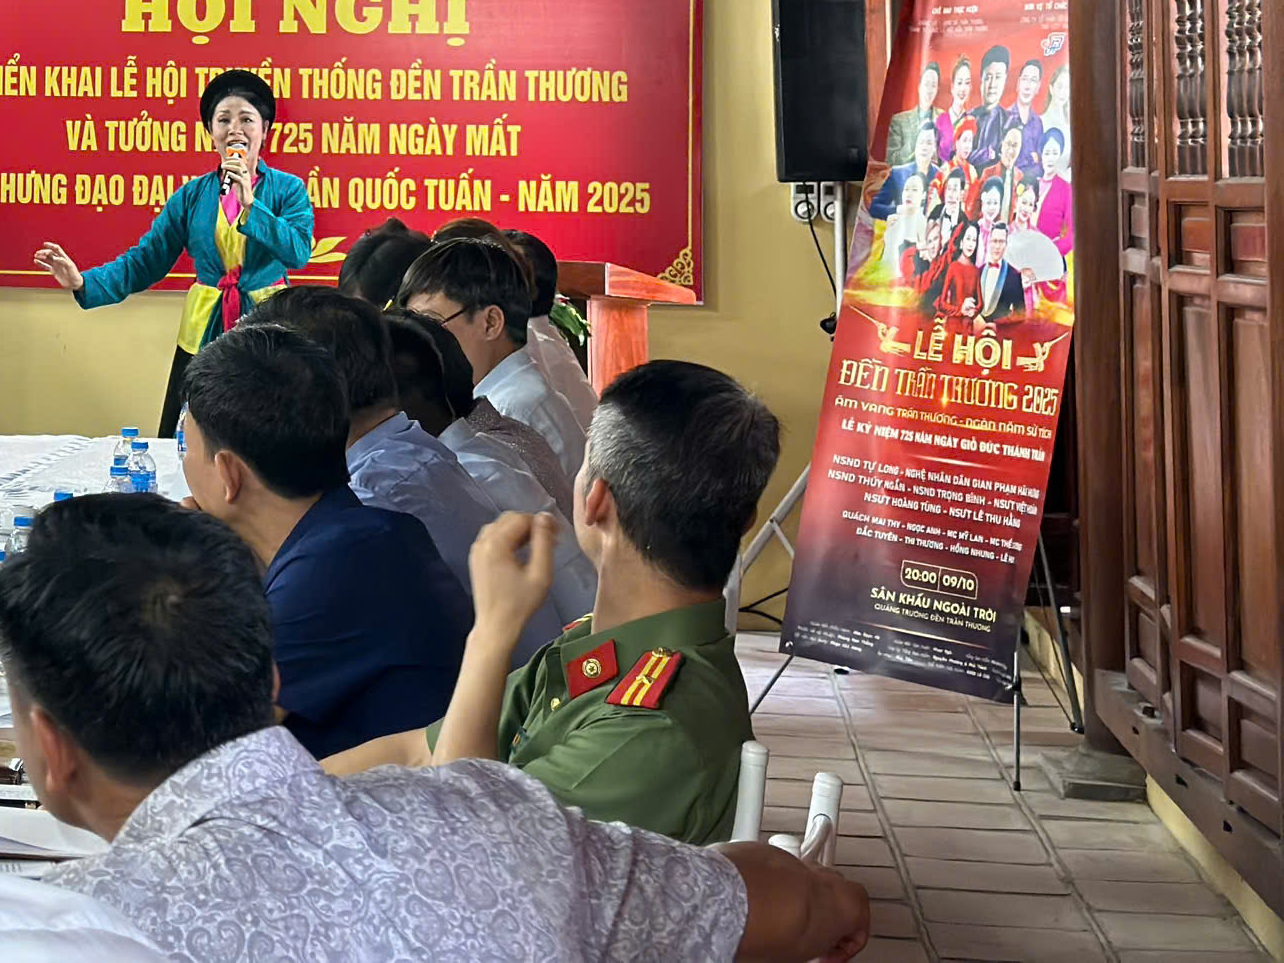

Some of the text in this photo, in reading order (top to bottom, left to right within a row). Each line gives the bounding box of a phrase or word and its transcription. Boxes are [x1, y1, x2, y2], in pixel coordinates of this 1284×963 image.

[45, 65, 102, 97] KHAI
[111, 55, 138, 98] LỄ
[146, 60, 187, 105] HỘI
[299, 57, 382, 100] THỐNG
[390, 59, 441, 100] ĐỀN
[449, 59, 516, 101] TRẦN
[525, 67, 628, 102] THƯƠNG
[66, 114, 98, 151] VÀ
[105, 111, 187, 152] TƯỞNG
[270, 122, 313, 154] 725
[322, 116, 380, 154] NĂM
[389, 118, 457, 155] NGÀY
[466, 113, 521, 156] MẤT
[0, 170, 67, 204] HƯNG
[75, 174, 124, 211] ĐẠO
[133, 175, 174, 212] ĐẠI
[349, 167, 416, 213] QUỐC
[424, 168, 492, 211] TUẤN
[499, 193, 510, 203] -
[519, 173, 579, 213] NĂM
[587, 182, 651, 213] 2025
[913, 317, 1013, 376] LỄ HỘI
[838, 358, 1059, 417] ĐỀN TRẦN THƯƠNG 2025
[874, 425, 899, 440] NIỆM
[900, 429, 915, 442] 725
[979, 440, 1000, 455] ĐỨC
[1002, 444, 1030, 459] THÁNH
[828, 469, 855, 482] NSND
[913, 485, 935, 497] NSND
[937, 489, 963, 503] TRỌNG
[833, 454, 860, 468] NSND
[878, 463, 900, 476] LONG
[905, 467, 927, 482] NGHỆ
[972, 478, 992, 491] GIAN
[842, 510, 870, 523] QUÁCH
[871, 517, 887, 526] MAI
[969, 534, 983, 543] LAN
[891, 497, 919, 511] HOÀNG
[985, 513, 1002, 525] THU
[970, 547, 995, 560] NHUNG
[904, 567, 975, 591] 20:00 09/10
[870, 586, 997, 623] SÂN KHẤU NGOÀI TRỜI
